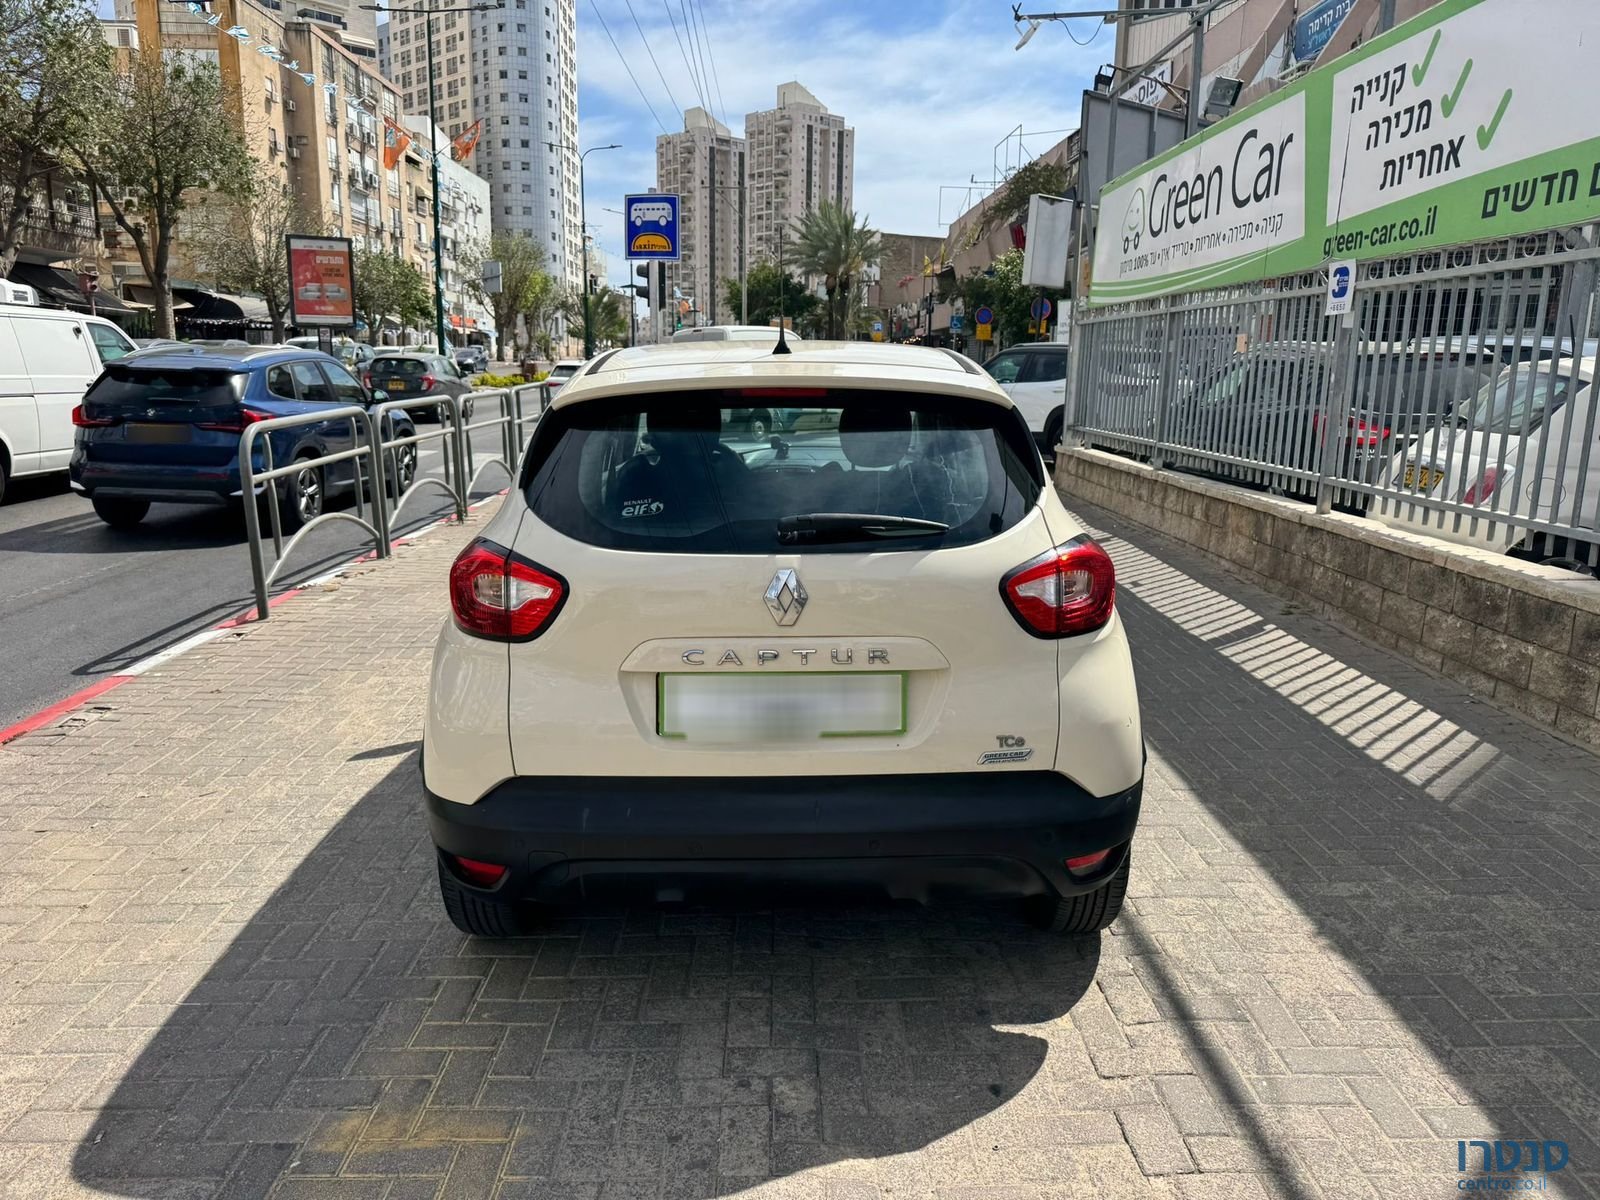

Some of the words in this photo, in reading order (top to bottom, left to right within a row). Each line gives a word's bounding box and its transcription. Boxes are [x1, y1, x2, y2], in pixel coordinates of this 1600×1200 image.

[1335, 0, 1351, 19] בית
[1308, 9, 1334, 36] קדימה
[1351, 62, 1407, 114] קנייה
[1366, 98, 1432, 151] מכירה
[1379, 134, 1466, 191] אחריות
[1149, 165, 1223, 238] Green
[1232, 128, 1294, 209] Car
[1481, 168, 1579, 219] חדשים
[1227, 222, 1253, 244] מכירה
[1261, 213, 1283, 238] קניה
[1194, 231, 1222, 253] אחריות
[621, 504, 649, 517] elf
[681, 648, 890, 666] CAPTUR
[996, 734, 1026, 749] TCe
